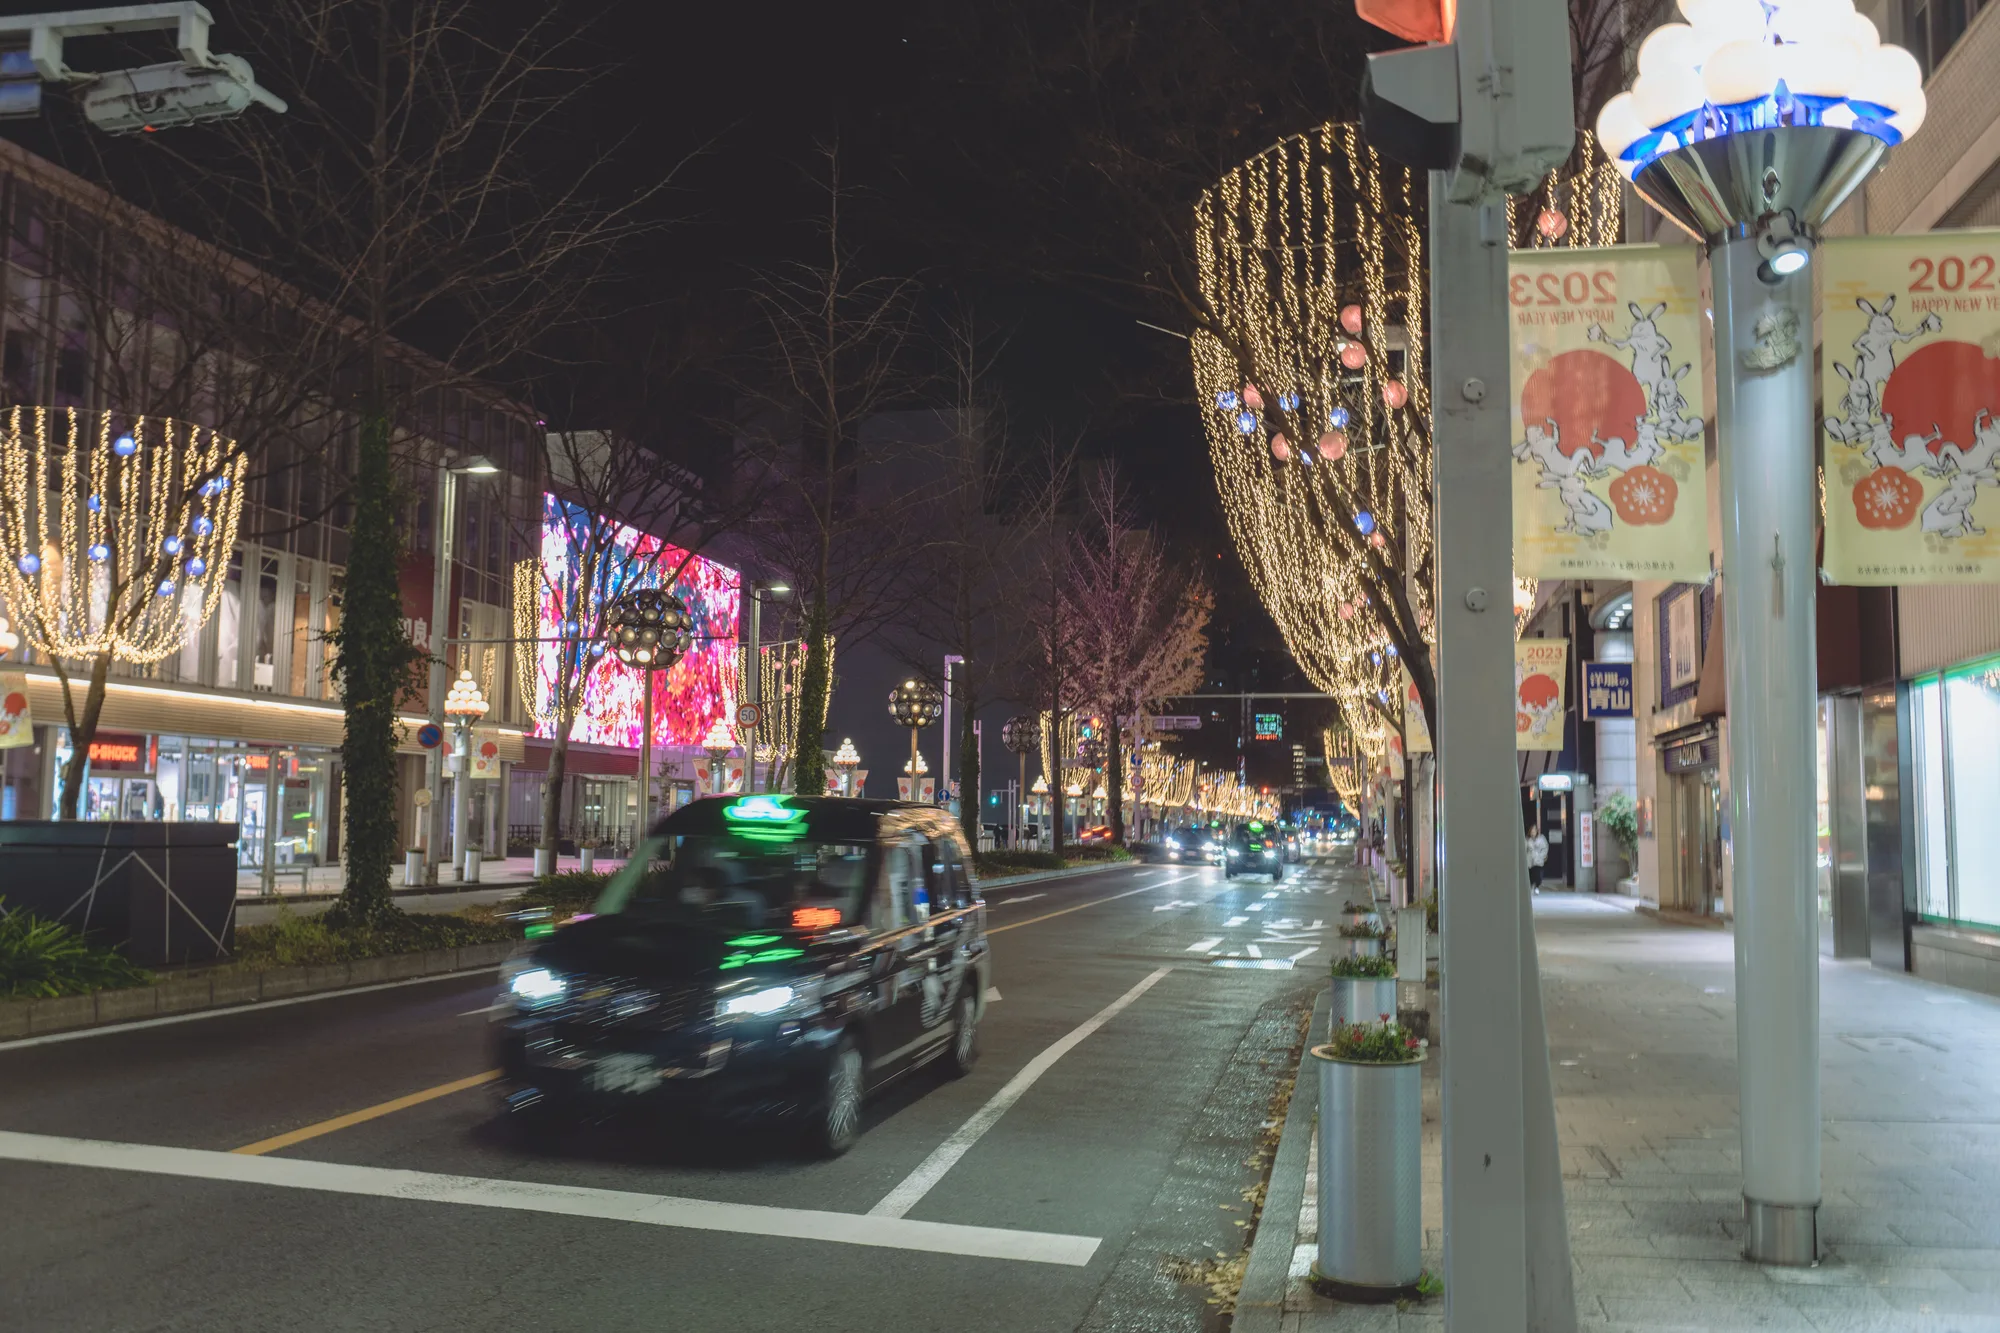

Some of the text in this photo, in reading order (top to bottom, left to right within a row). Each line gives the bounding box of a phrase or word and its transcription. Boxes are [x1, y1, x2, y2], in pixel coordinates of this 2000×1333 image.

[1908, 254, 2000, 293] 202
[1911, 296, 1951, 313] HAPPY
[1954, 296, 1982, 312] NEW
[1527, 647, 1562, 660] 2023
[1590, 671, 1629, 687] 洋服の
[1589, 687, 1631, 710] 青山
[741, 709, 756, 722] 50
[89, 743, 138, 762] G-SHOCK
